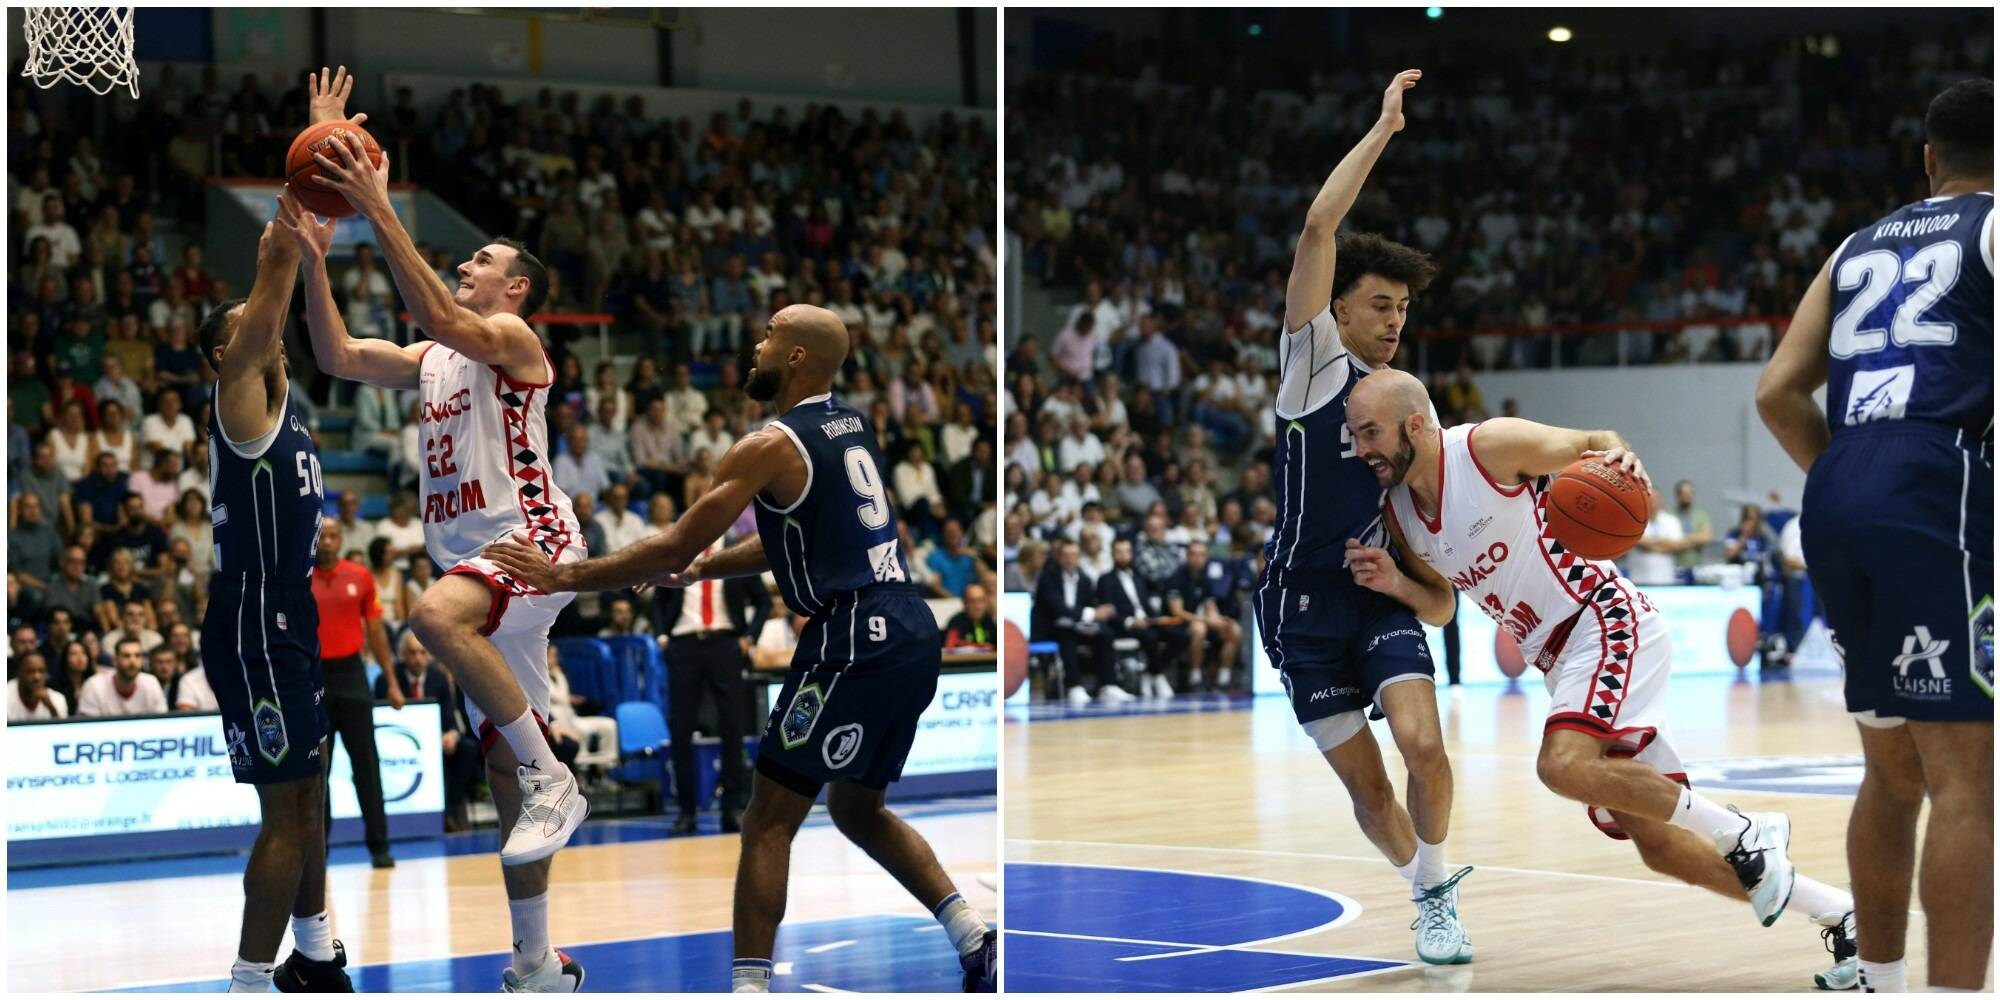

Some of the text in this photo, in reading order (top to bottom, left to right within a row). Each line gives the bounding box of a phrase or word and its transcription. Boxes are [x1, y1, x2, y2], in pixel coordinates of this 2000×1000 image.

[1873, 213, 1960, 240] KIRKWOOD
[1829, 240, 1962, 360] 22
[821, 416, 864, 440] ROBINSON
[426, 434, 457, 478] 22
[844, 445, 889, 530] 9
[868, 616, 887, 642] 9
[1893, 676, 1952, 693] L'AISNE
